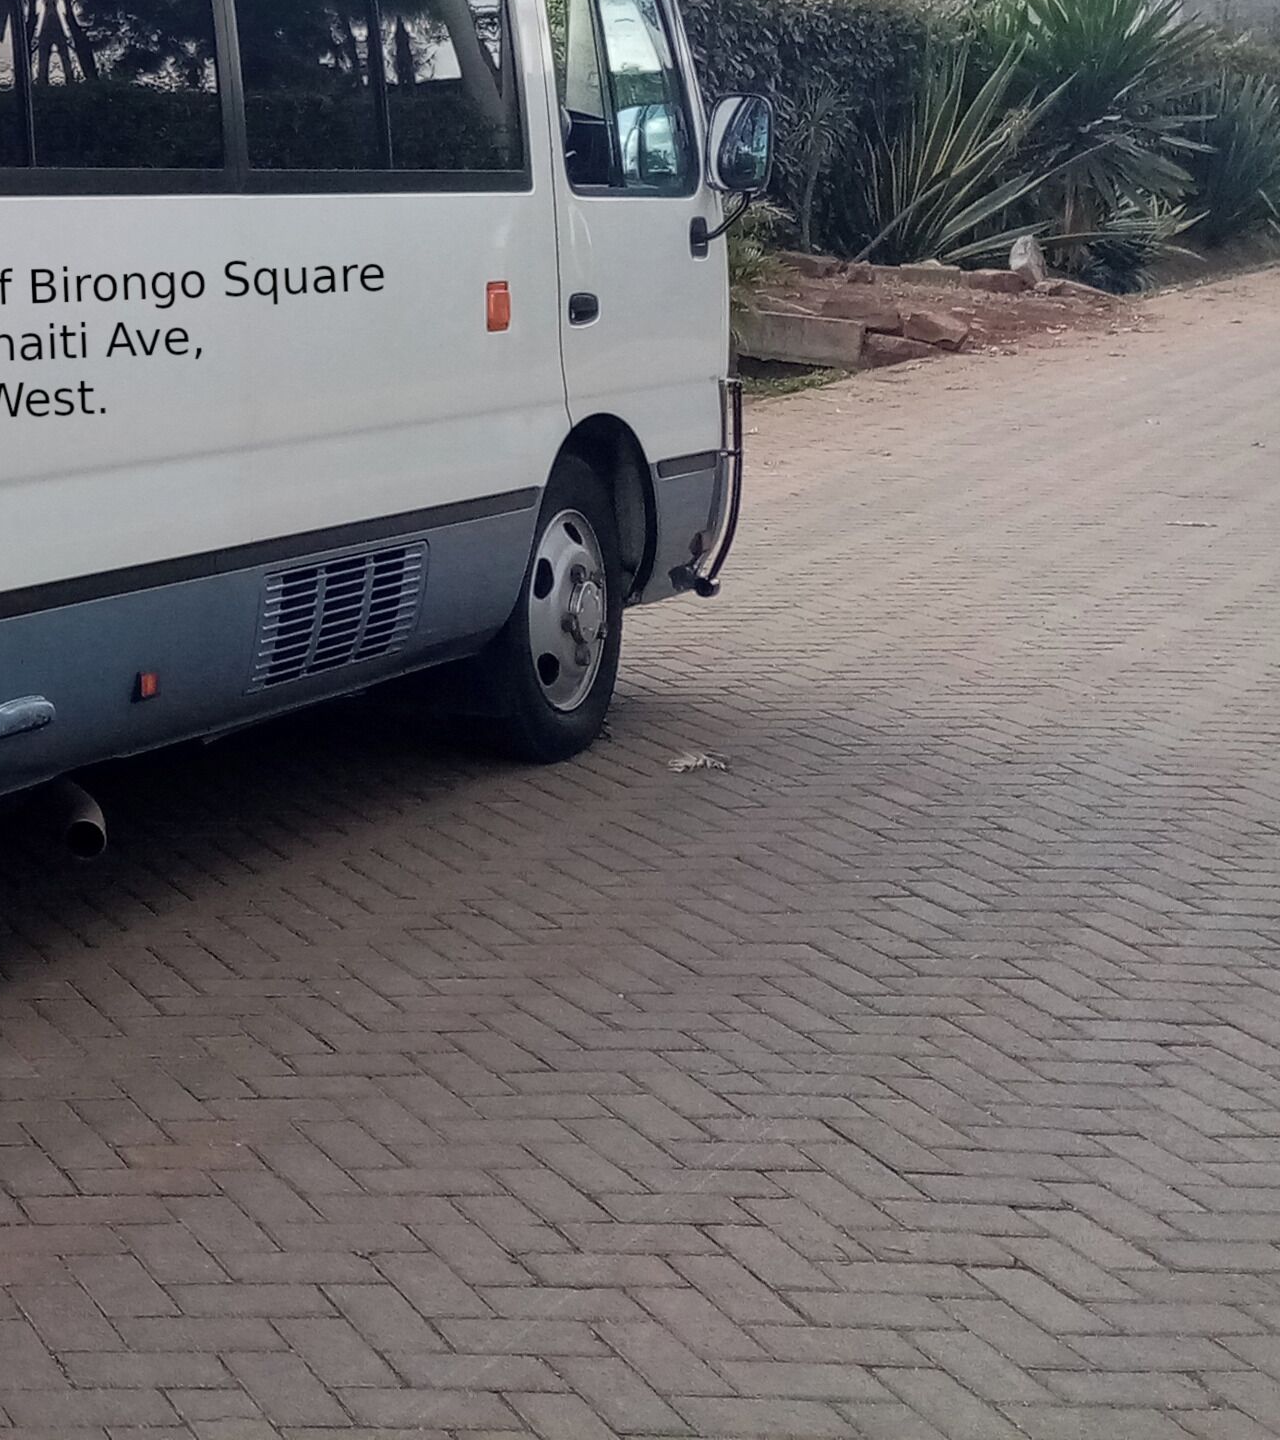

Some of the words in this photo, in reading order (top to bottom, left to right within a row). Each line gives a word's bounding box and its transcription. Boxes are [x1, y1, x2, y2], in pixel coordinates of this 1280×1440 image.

[30, 265, 205, 310] Birongo
[224, 260, 385, 305] Square
[106, 321, 203, 360] Ave,
